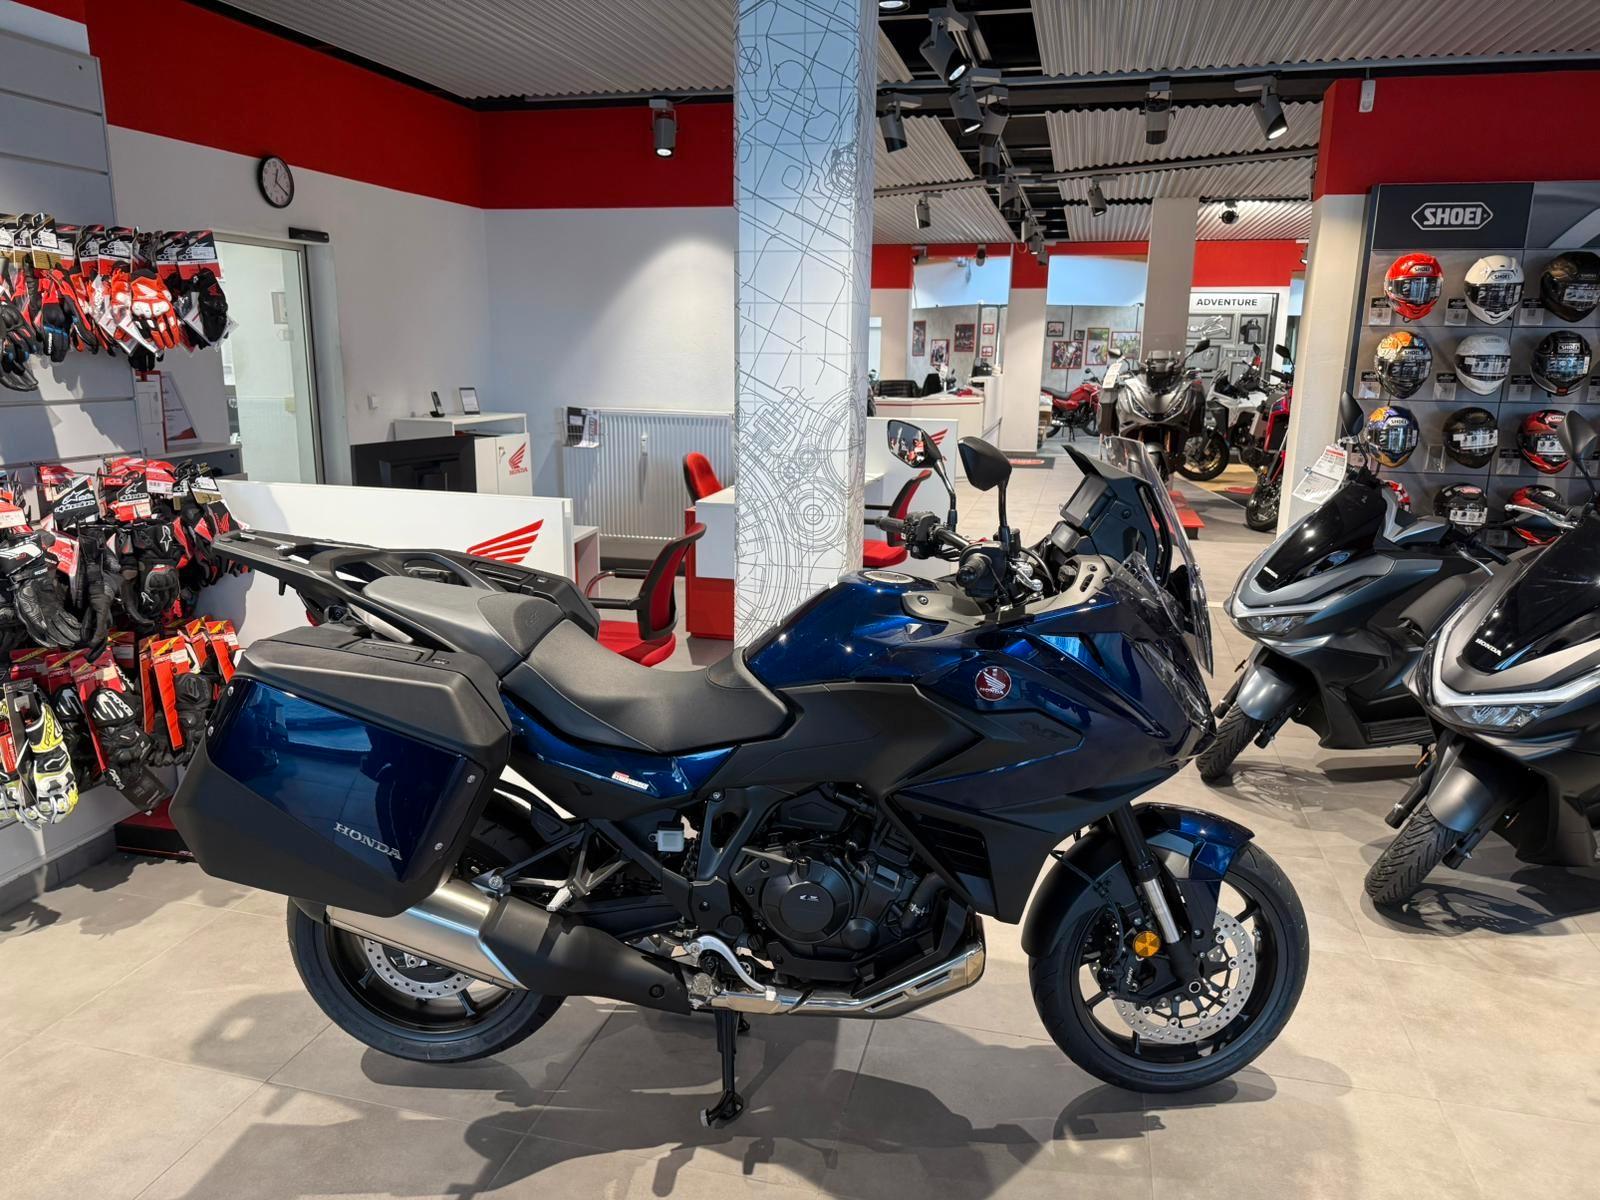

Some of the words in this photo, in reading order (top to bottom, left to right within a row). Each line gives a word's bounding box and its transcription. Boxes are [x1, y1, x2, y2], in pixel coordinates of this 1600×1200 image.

[1423, 207, 1482, 225] SHOEI
[1196, 298, 1258, 306] ADVENTURE
[1475, 638, 1502, 656] HONDA
[333, 822, 402, 860] HONDA
